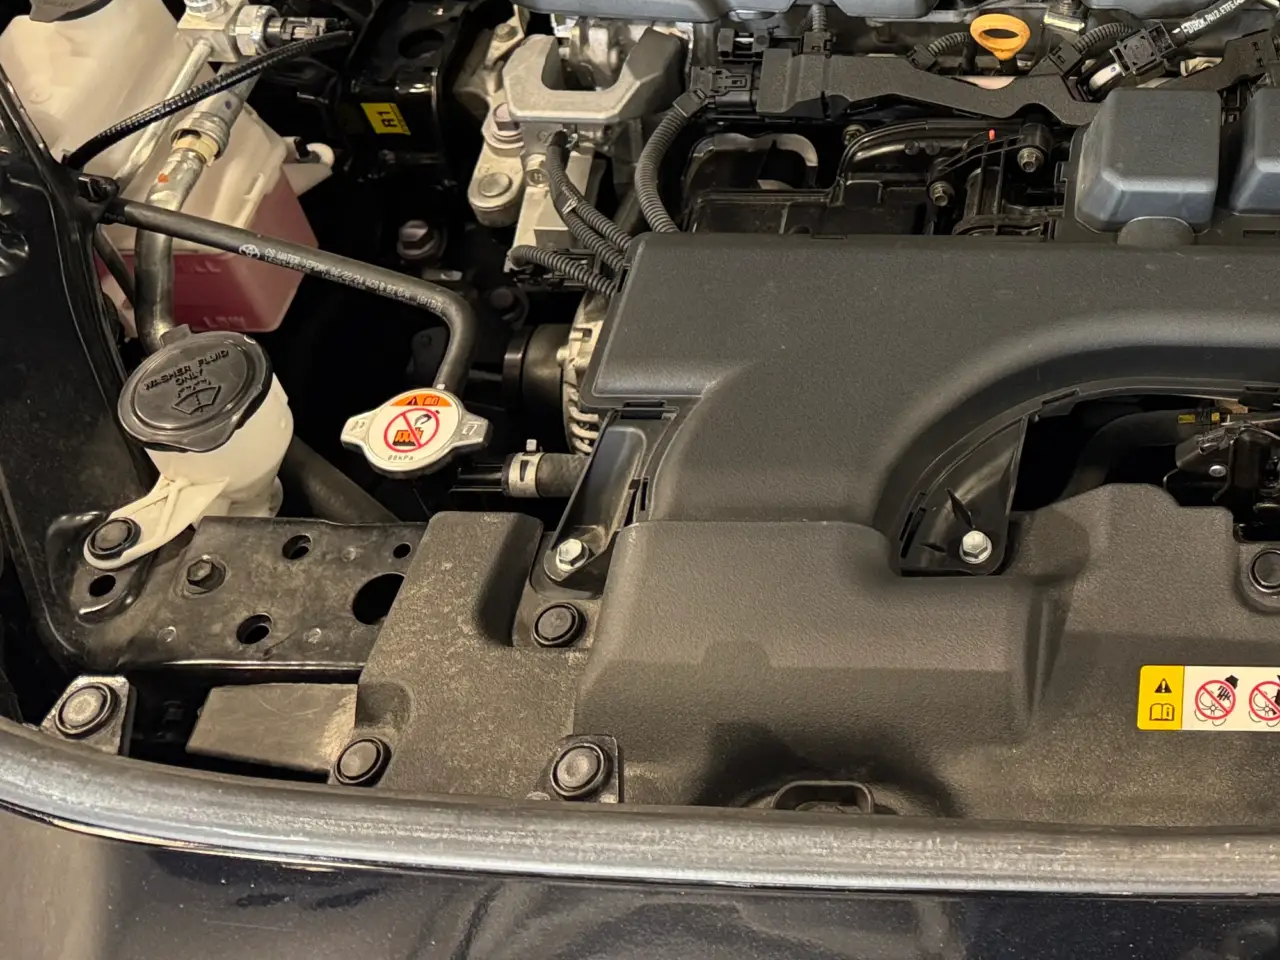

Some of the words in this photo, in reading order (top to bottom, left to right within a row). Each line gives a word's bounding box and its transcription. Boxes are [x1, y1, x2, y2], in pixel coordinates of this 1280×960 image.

[144, 364, 192, 391] WASHER
[197, 349, 231, 367] FLUID
[175, 368, 204, 386] ONLY
